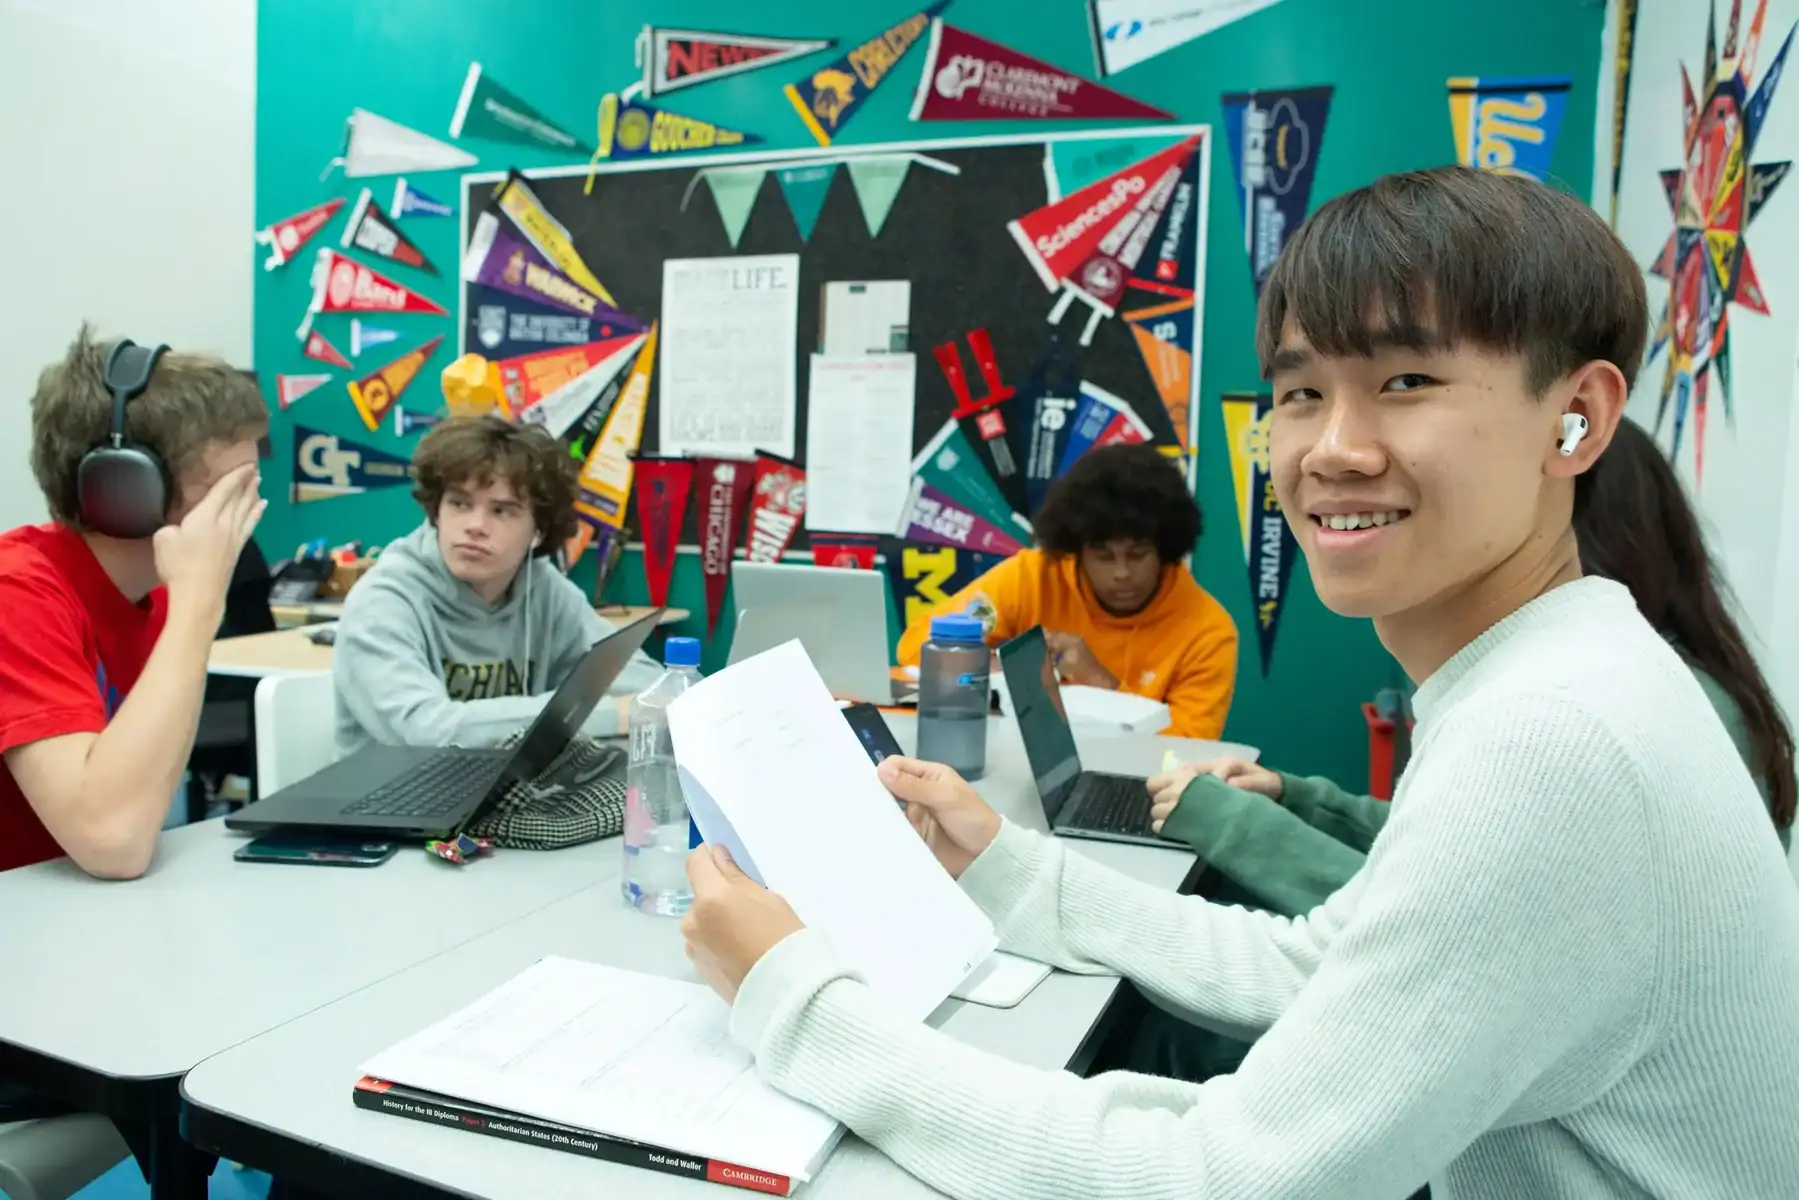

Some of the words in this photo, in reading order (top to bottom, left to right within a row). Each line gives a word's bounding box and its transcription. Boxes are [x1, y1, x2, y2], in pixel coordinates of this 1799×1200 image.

[985, 61, 1082, 96] CLAREMONT
[704, 485, 723, 576] CHICAGO
[1259, 517, 1282, 599] IRVINE
[383, 1099, 404, 1111] History
[405, 1103, 414, 1112] for
[415, 1106, 426, 1114] the
[426, 1108, 433, 1116] IB
[434, 1110, 459, 1121] Diploma
[488, 1121, 530, 1136] Authoritarian
[531, 1130, 551, 1140] States
[551, 1133, 570, 1145] (20th
[570, 1138, 598, 1151] Century)
[649, 1154, 665, 1164] Todd
[666, 1157, 679, 1167] and
[680, 1160, 702, 1171] Waller
[722, 1168, 777, 1186] CAMBRIDGE
